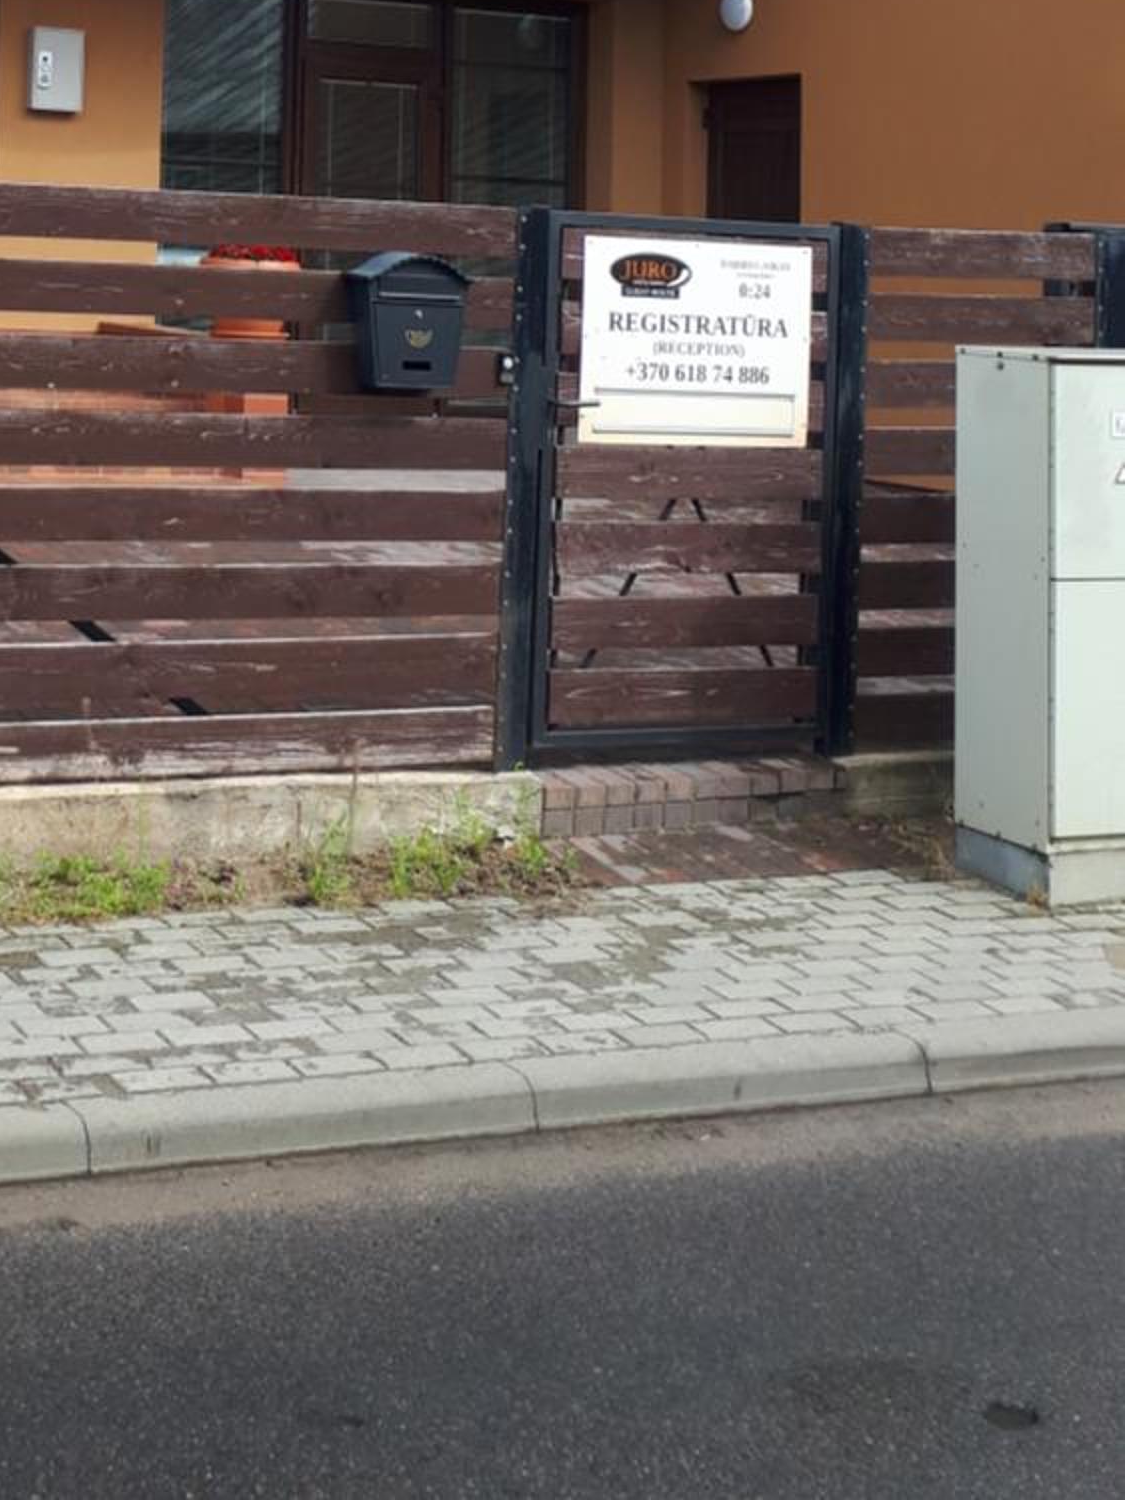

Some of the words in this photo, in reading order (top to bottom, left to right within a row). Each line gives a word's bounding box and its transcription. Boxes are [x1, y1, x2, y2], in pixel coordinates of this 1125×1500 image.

[622, 260, 677, 280] JURO
[608, 312, 789, 338] REGISTRATŪRA
[652, 341, 745, 358] (RECEPTION)
[626, 362, 670, 382] +370
[675, 364, 707, 383] 618
[713, 365, 734, 383] 74
[738, 366, 770, 385] 886
